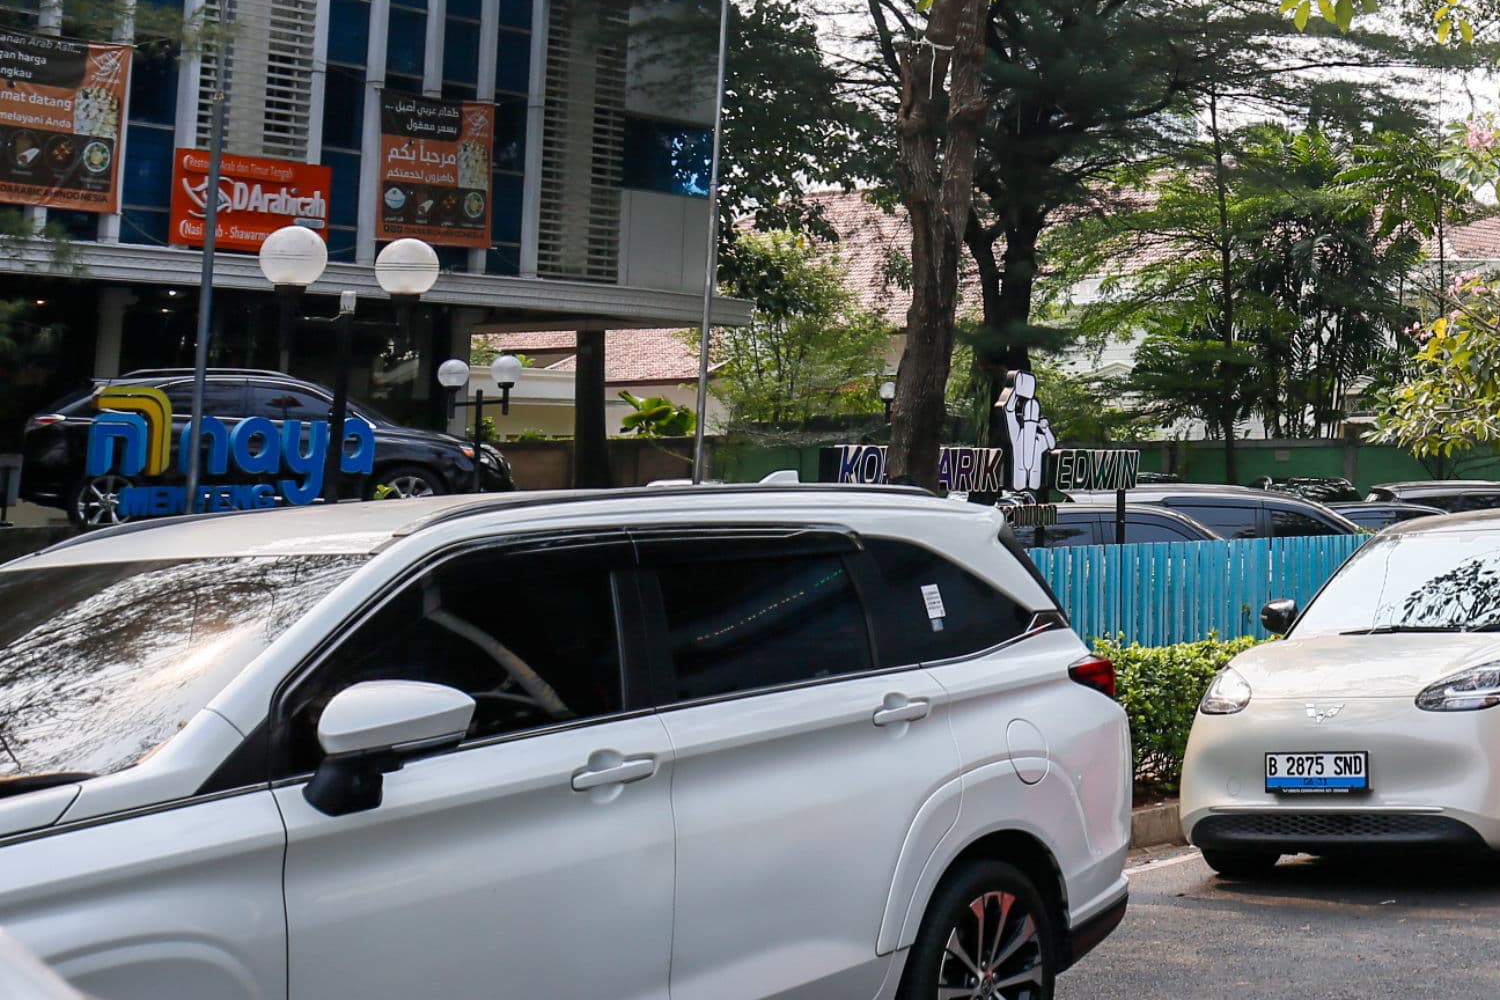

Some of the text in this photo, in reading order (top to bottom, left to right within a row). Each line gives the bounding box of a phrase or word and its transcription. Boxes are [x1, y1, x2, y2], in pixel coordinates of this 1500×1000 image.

[18, 51, 47, 66] harga
[28, 92, 73, 112] datang
[45, 116, 72, 129] Anda
[185, 221, 203, 236] Nasi
[179, 415, 376, 506] naya
[1055, 448, 1141, 490] EDWIN
[1268, 755, 1362, 776] B 2875 SND
